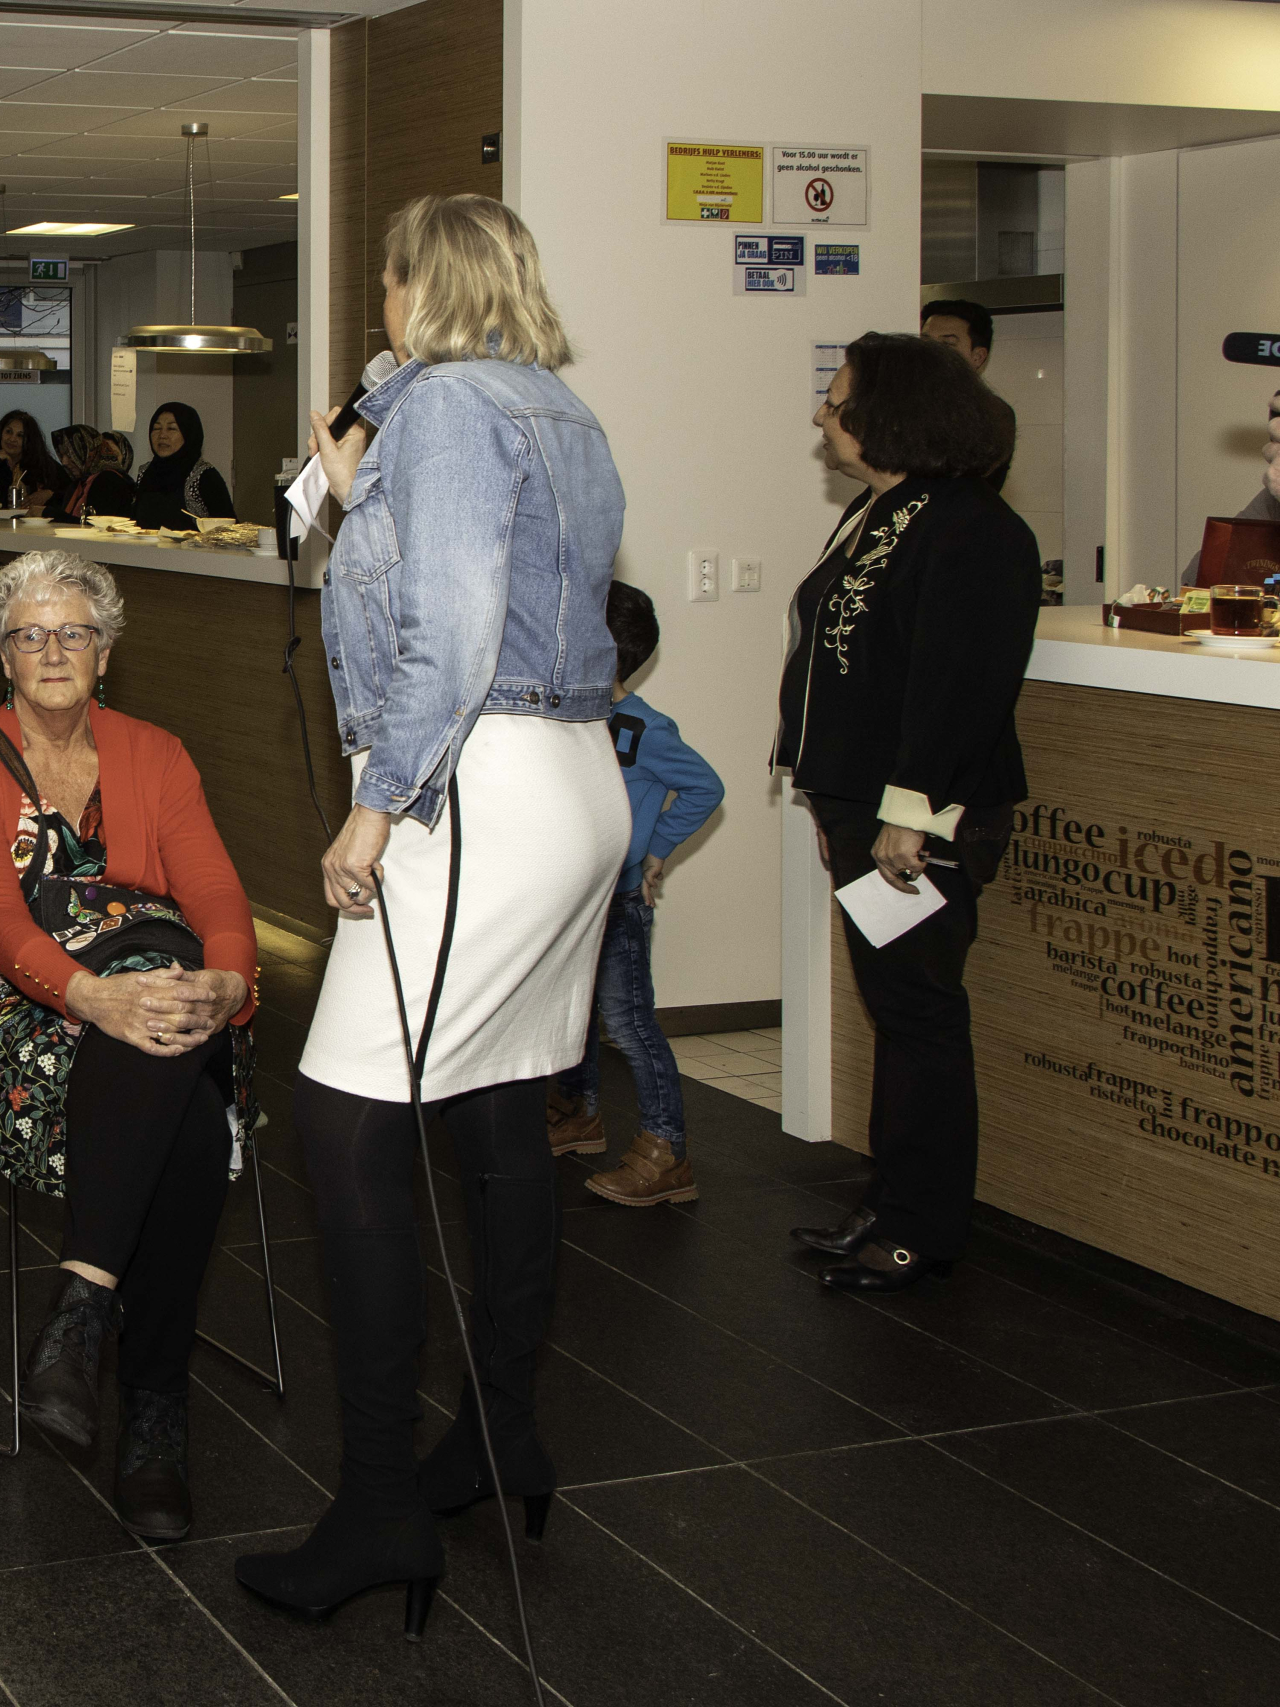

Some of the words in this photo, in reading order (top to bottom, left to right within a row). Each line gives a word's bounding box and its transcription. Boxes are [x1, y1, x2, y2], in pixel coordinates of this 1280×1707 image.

[670, 147, 700, 156] BEDRIJFS
[722, 150, 761, 158] VERLENERS:
[781, 151, 797, 159] Voor
[798, 151, 816, 159] 15.00
[830, 152, 849, 160] wordt
[795, 164, 820, 172] alcohol
[821, 165, 862, 173] geschonken.
[738, 241, 759, 250] PINNEN
[738, 251, 746, 259] JA
[747, 251, 767, 259] GRAAG
[772, 251, 793, 260] PIN
[829, 247, 858, 255] VERKOPEN
[747, 271, 770, 280] BETAAL
[747, 280, 761, 288] HIER
[762, 280, 775, 288] OOK
[1, 372, 11, 380] TOT
[13, 372, 32, 380] ZIENS
[1011, 804, 1105, 849] offee
[1136, 830, 1191, 849] robusta
[1012, 840, 1100, 886] lungo
[1117, 826, 1225, 889] iced
[1023, 885, 1108, 917] arabica
[1102, 870, 1176, 914] cup
[1107, 898, 1146, 913] morning
[1253, 886, 1264, 944] espresso
[1027, 900, 1161, 963] frappe
[1045, 941, 1118, 976] barista
[1166, 945, 1201, 969] hot
[1201, 897, 1223, 1029] frappochino
[1052, 963, 1100, 983] melange
[1070, 978, 1099, 993] frappe
[1130, 962, 1202, 990] robusta
[1227, 849, 1253, 1098] americano
[1099, 977, 1206, 1021] coffee
[1104, 998, 1131, 1017] hot
[1130, 1010, 1228, 1049] melange
[1122, 1025, 1231, 1069] frappochino
[1023, 1052, 1089, 1083] robusta
[1087, 1061, 1158, 1099] frappe
[1179, 1056, 1226, 1080] barista
[1257, 1044, 1272, 1101] frappe
[1090, 1085, 1157, 1116] ristretto
[1159, 1089, 1172, 1120] hot
[1138, 1114, 1256, 1167] chocolate
